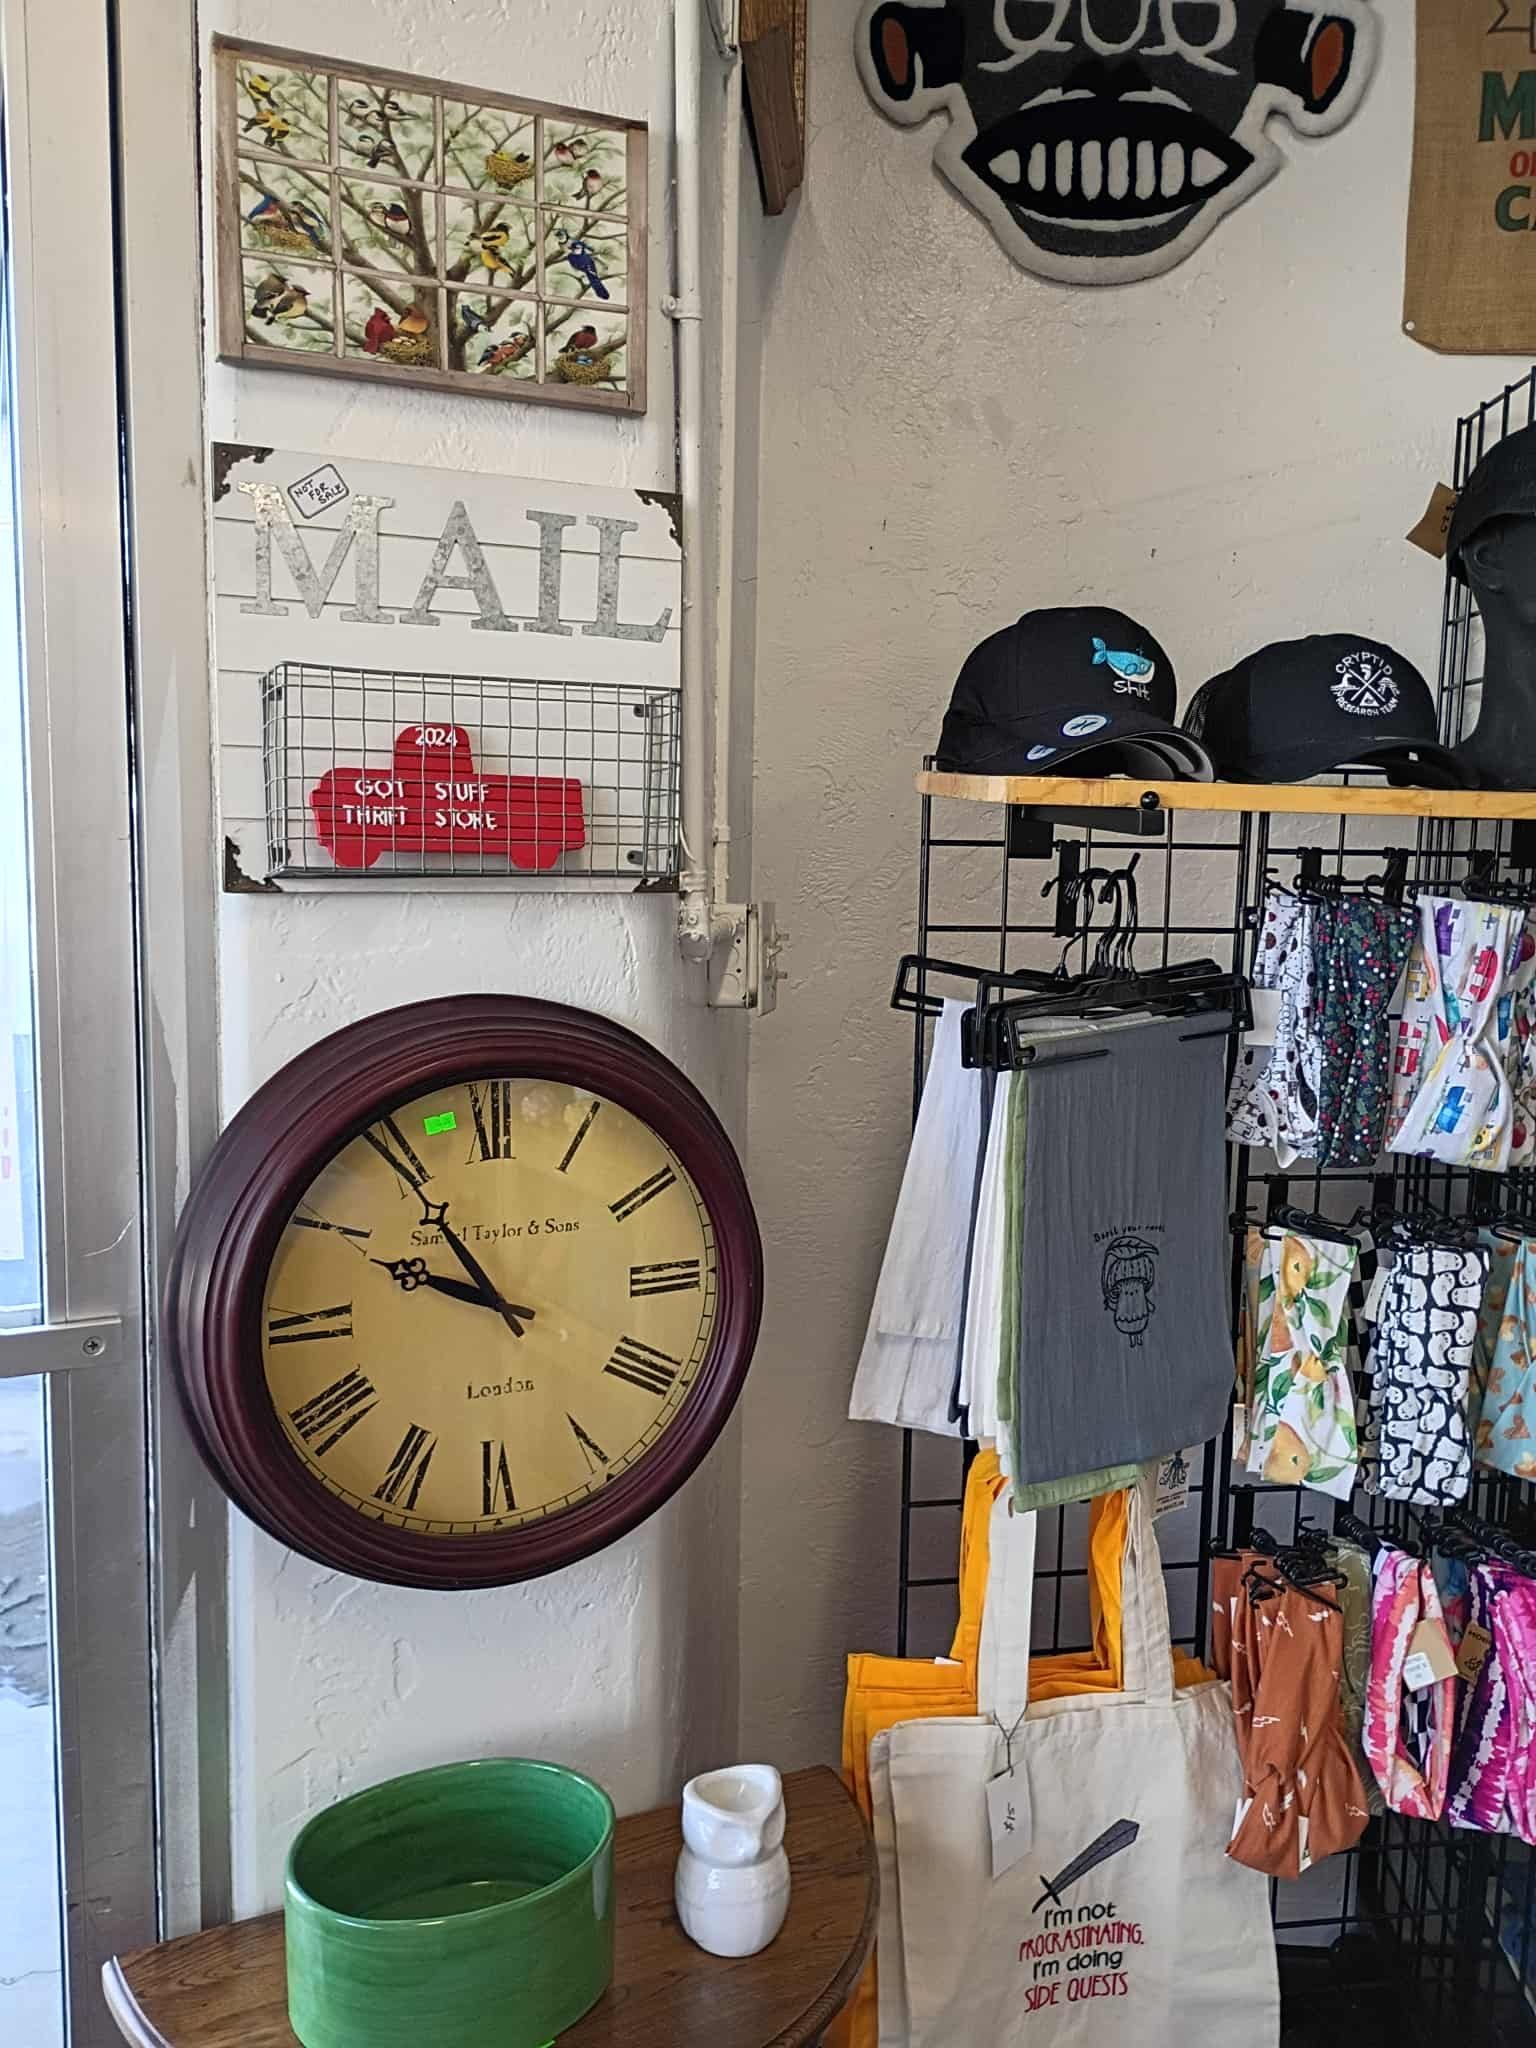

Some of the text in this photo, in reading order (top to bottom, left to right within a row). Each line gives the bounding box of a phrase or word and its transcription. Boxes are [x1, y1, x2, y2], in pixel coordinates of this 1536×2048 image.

[294, 479, 313, 498] NOT
[308, 482, 329, 501] FOR
[318, 483, 344, 504] SALE
[237, 481, 673, 643] MAIL
[1336, 652, 1393, 675] CRYPTID
[415, 726, 458, 748] 2024
[355, 779, 490, 803] GOT STUFF
[342, 804, 498, 831] THRIFT STORE
[410, 1218, 580, 1247] Saml Taylor & Sons
[467, 1376, 536, 1400] London
[1078, 1902, 1117, 1923] not
[1019, 1920, 1144, 1962] PROCRASTINATING.
[1066, 1950, 1123, 1971] doing
[1024, 1971, 1128, 2013] SIDE QUESTS
